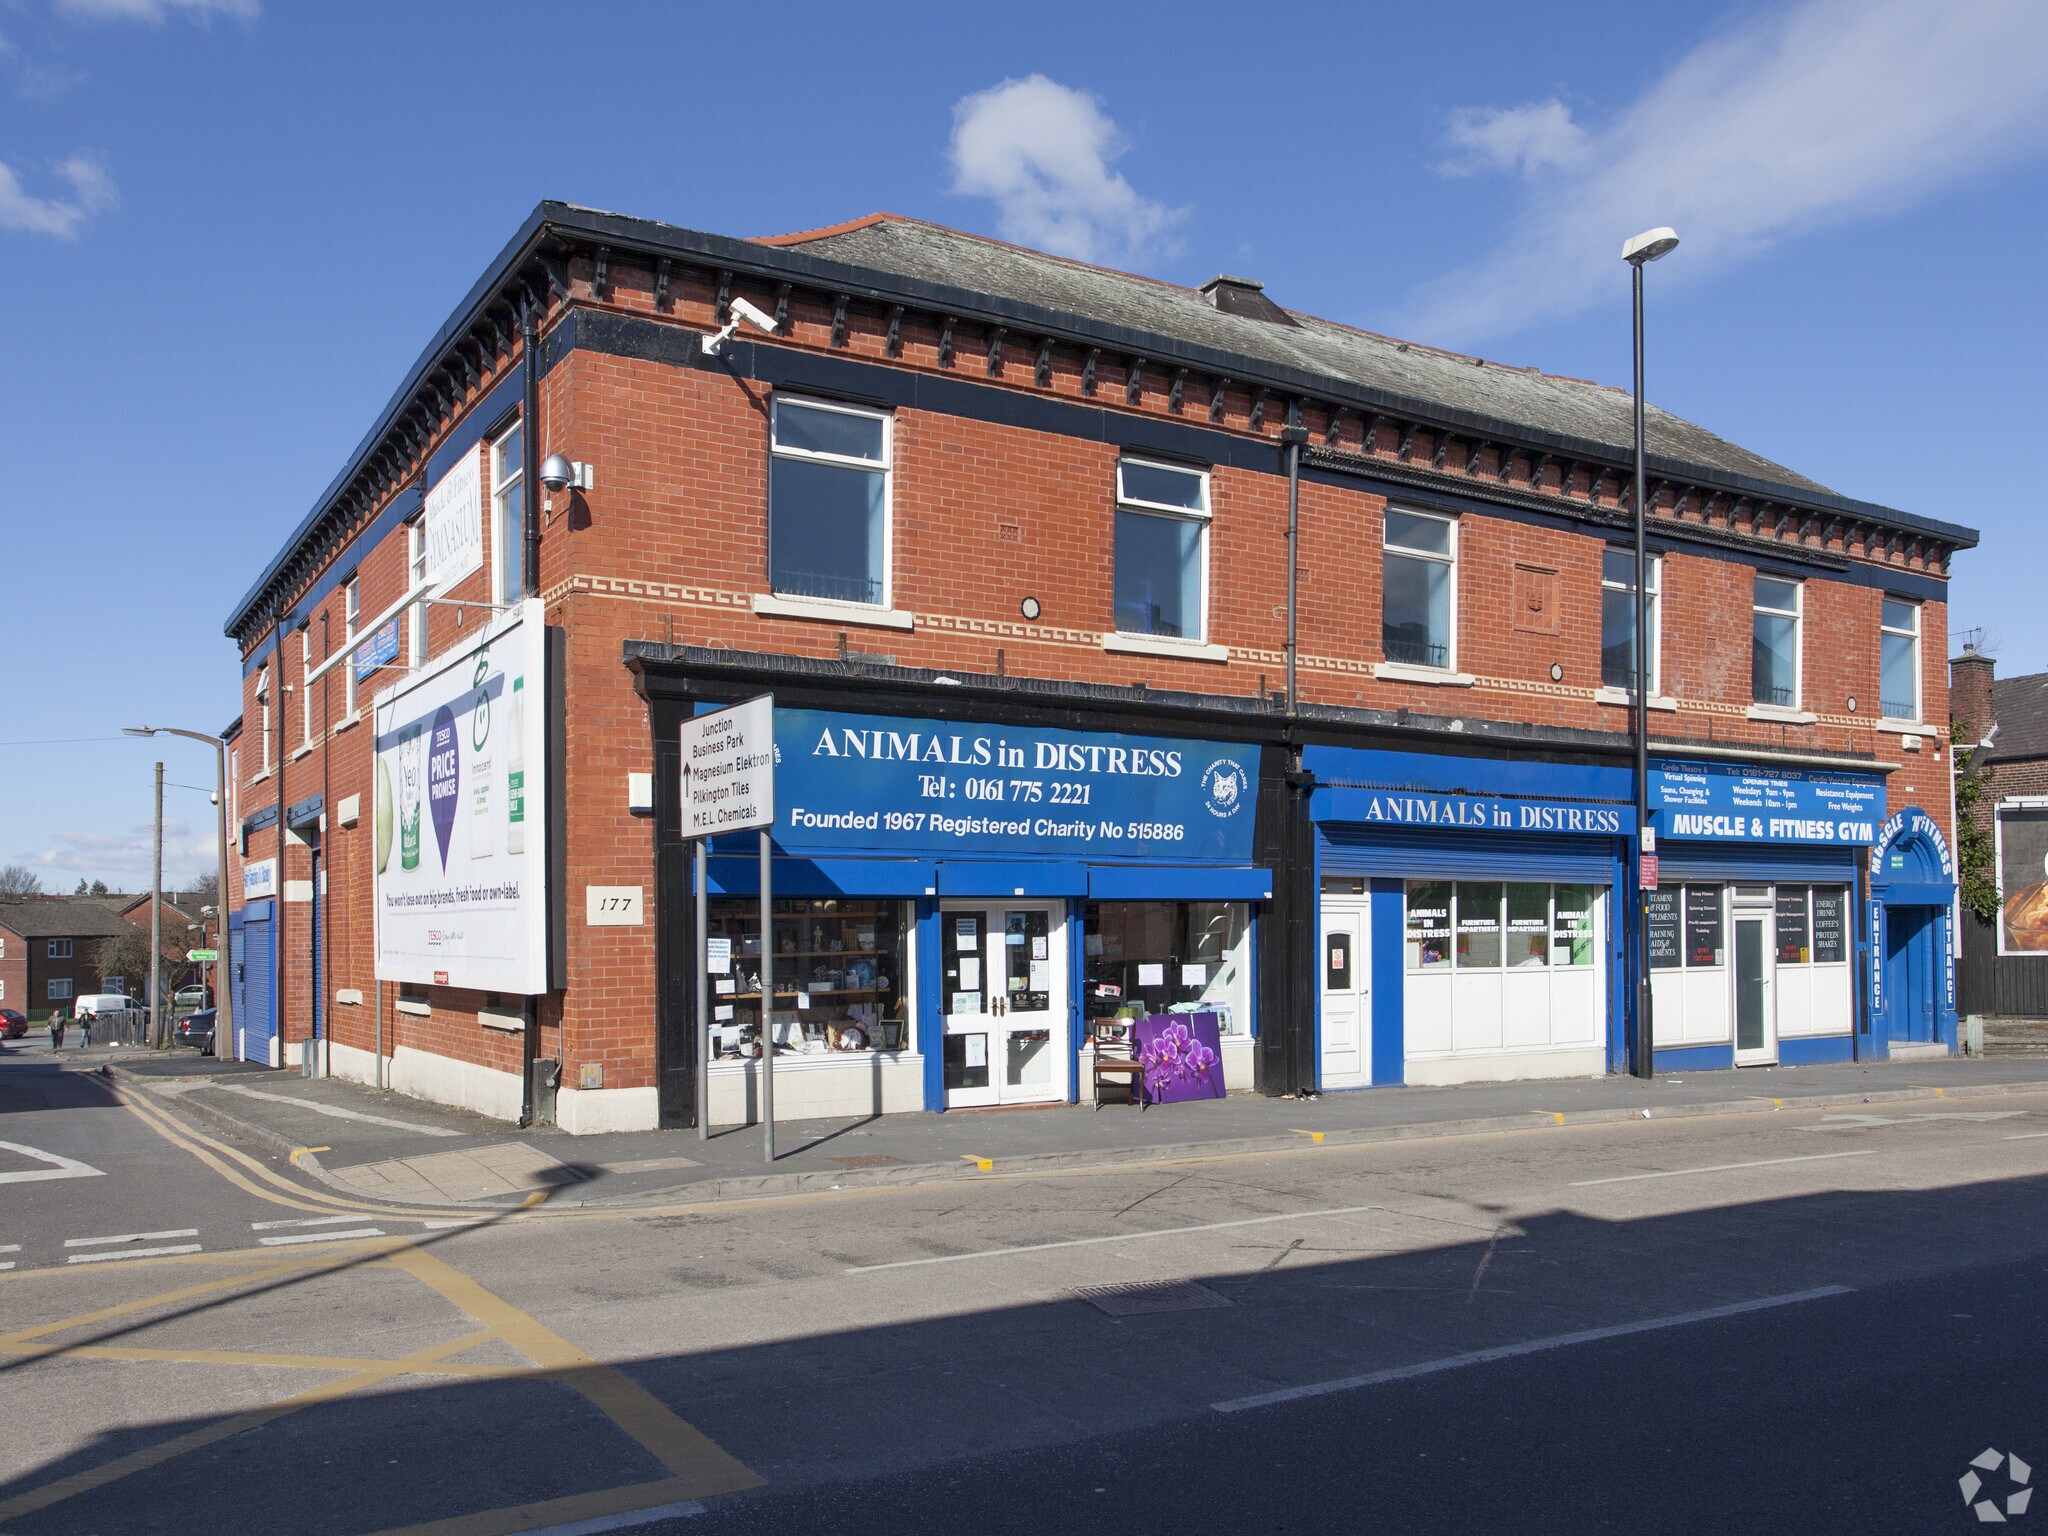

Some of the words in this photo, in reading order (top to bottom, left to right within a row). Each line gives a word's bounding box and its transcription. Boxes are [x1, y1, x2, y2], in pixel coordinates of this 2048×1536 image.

[428, 483, 479, 574] GYMNASIUM
[702, 718, 732, 737] Junction
[436, 728, 450, 742] TESCO
[693, 741, 724, 758] Business
[727, 732, 744, 749] Park
[813, 727, 991, 767] ANIMALS
[997, 739, 1025, 768] in
[1034, 742, 1182, 777] DISTRESS
[431, 749, 455, 782] PRICE
[693, 762, 733, 782] Magnesium
[736, 753, 770, 771] Elektron
[1661, 764, 1679, 772] Cardio
[1681, 765, 1702, 773] Theatre
[404, 766, 416, 789] Yeo
[1201, 775, 1209, 787] THE
[1206, 759, 1227, 775] CHARITY
[1228, 759, 1241, 769] THAT
[1239, 769, 1247, 789] CARES
[1664, 773, 1682, 781] Virtual
[1684, 774, 1706, 784] Spinning
[1726, 767, 1740, 775] Tel:
[1743, 769, 1779, 778] 0161-727
[1782, 772, 1802, 780] 8037
[1743, 778, 1769, 786] OPENING
[1808, 775, 1827, 784] Cardio
[1828, 776, 1851, 785] Vascular
[1852, 778, 1880, 789] Equipment
[431, 778, 455, 800] PROMISE
[694, 786, 729, 804] Pilkington
[732, 782, 749, 797] Tiles
[965, 777, 1005, 801] 0161
[1008, 780, 1042, 803] 775
[1049, 782, 1090, 805] 2221
[1660, 786, 1677, 794] Sauna,
[1679, 787, 1704, 797] Changing
[1705, 788, 1710, 796] &
[1732, 786, 1761, 796] Weekdays
[1765, 788, 1778, 796] 9am
[1783, 789, 1795, 798] 9pm
[1816, 788, 1845, 797] Resistance
[1845, 790, 1874, 800] Equipment
[1664, 795, 1683, 803] Shower
[1684, 796, 1708, 805] Facilities
[1733, 797, 1762, 807] Weekends
[1765, 799, 1780, 807] 10am
[1786, 801, 1797, 810] 1pm
[1205, 801, 1211, 809] 24
[1209, 806, 1227, 818] HOURS
[1232, 802, 1240, 813] DAY
[1366, 796, 1485, 826] ANIMALS
[1493, 805, 1511, 827] in
[1519, 806, 1619, 832] DISTRESS
[1828, 802, 1841, 810] Free
[1841, 803, 1863, 813] Weights
[694, 812, 716, 827] M.E.L.
[718, 804, 756, 824] Chemicals
[792, 808, 878, 832] Founded
[883, 812, 924, 832] 1967
[930, 815, 1030, 836] Registered
[1035, 819, 1095, 841] Charity
[1099, 822, 1123, 838] No
[1127, 823, 1184, 841] 515886
[1673, 814, 1745, 836] MUSCLE
[1751, 818, 1763, 837] &
[1770, 818, 1834, 839] FITNESS
[1838, 822, 1873, 841] GYM
[1871, 813, 1903, 875] MUSCLE
[1920, 815, 1951, 875] FITNESS
[386, 893, 394, 907] You
[394, 893, 406, 907] won't
[406, 892, 414, 906] lose
[415, 893, 423, 905] out
[423, 894, 429, 905] on
[438, 888, 455, 906] brands,
[456, 886, 469, 903] fresh
[483, 888, 489, 900] or
[490, 881, 520, 900] own-label.
[600, 898, 632, 911] 177
[1816, 901, 1836, 909] ENERGY
[1410, 909, 1446, 918] ANIMALS
[1557, 911, 1590, 919] ANIMALS
[1424, 919, 1434, 928] IN
[1568, 920, 1577, 928] IN
[428, 930, 441, 941] TESCO
[1407, 929, 1450, 938] DISTRESS
[1554, 930, 1593, 938] DISTRESS
[1650, 930, 1675, 939] RAINING
